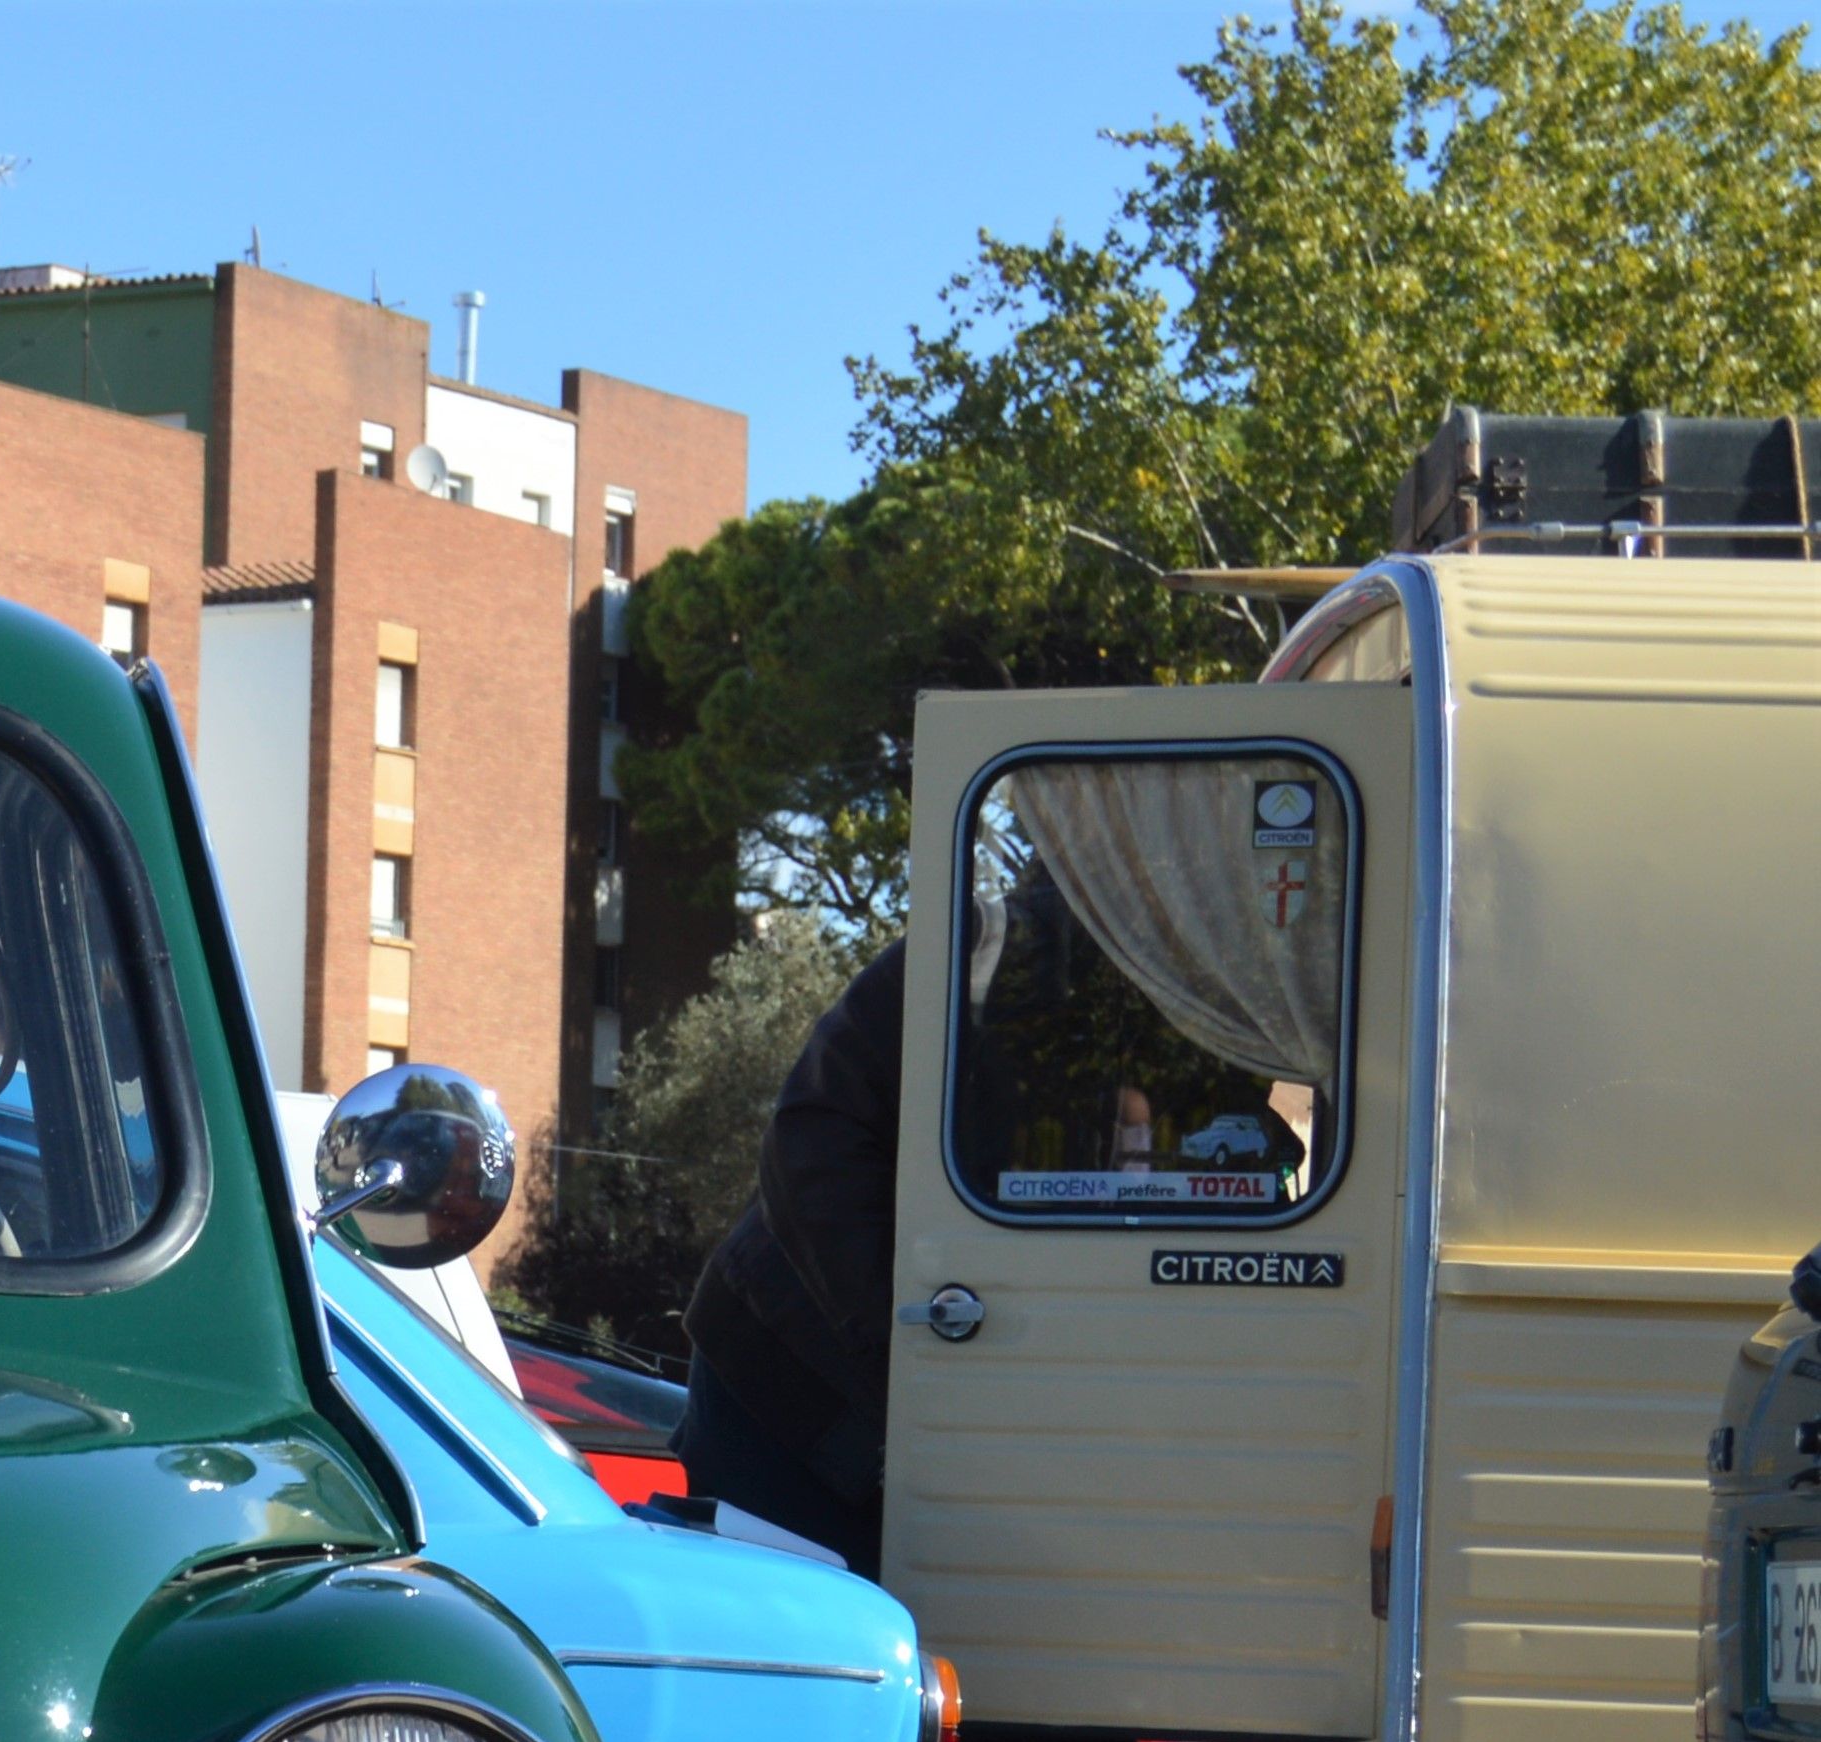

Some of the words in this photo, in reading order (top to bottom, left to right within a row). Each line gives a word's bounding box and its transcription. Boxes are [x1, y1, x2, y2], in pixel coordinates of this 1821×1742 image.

[1008, 1177, 1095, 1197] CITROËN
[1117, 1183, 1177, 1200] préfère
[1187, 1176, 1266, 1198] TOTAL
[1157, 1252, 1305, 1284] CITROËN
[1770, 1583, 1783, 1684] B
